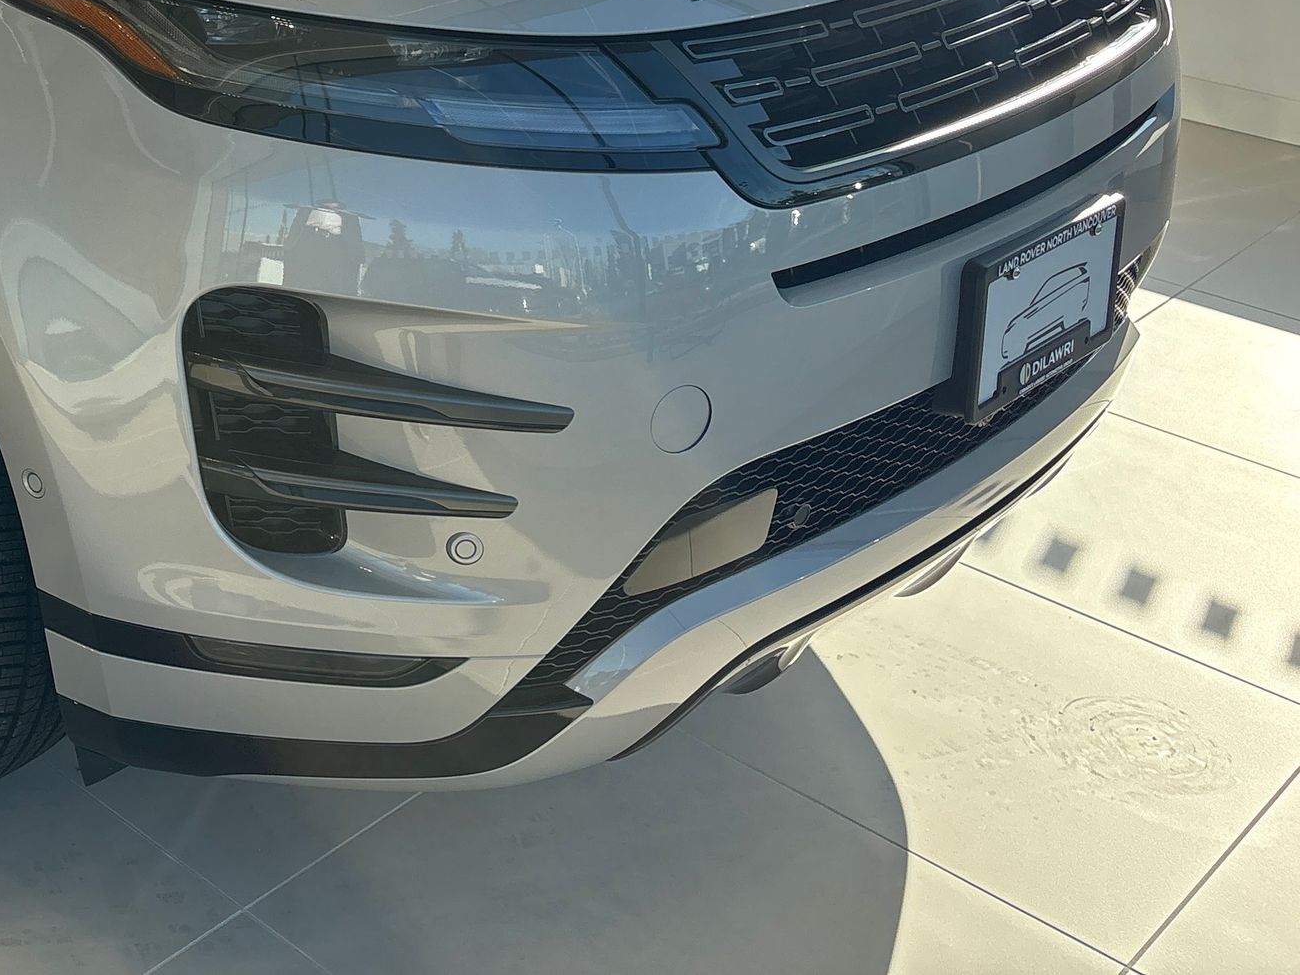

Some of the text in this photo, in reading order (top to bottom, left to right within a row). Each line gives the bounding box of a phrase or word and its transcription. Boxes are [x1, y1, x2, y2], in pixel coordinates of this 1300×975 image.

[998, 204, 1117, 277] LAND ROVER NORTH VANCOUVER
[1032, 339, 1075, 376] DILAWRI
